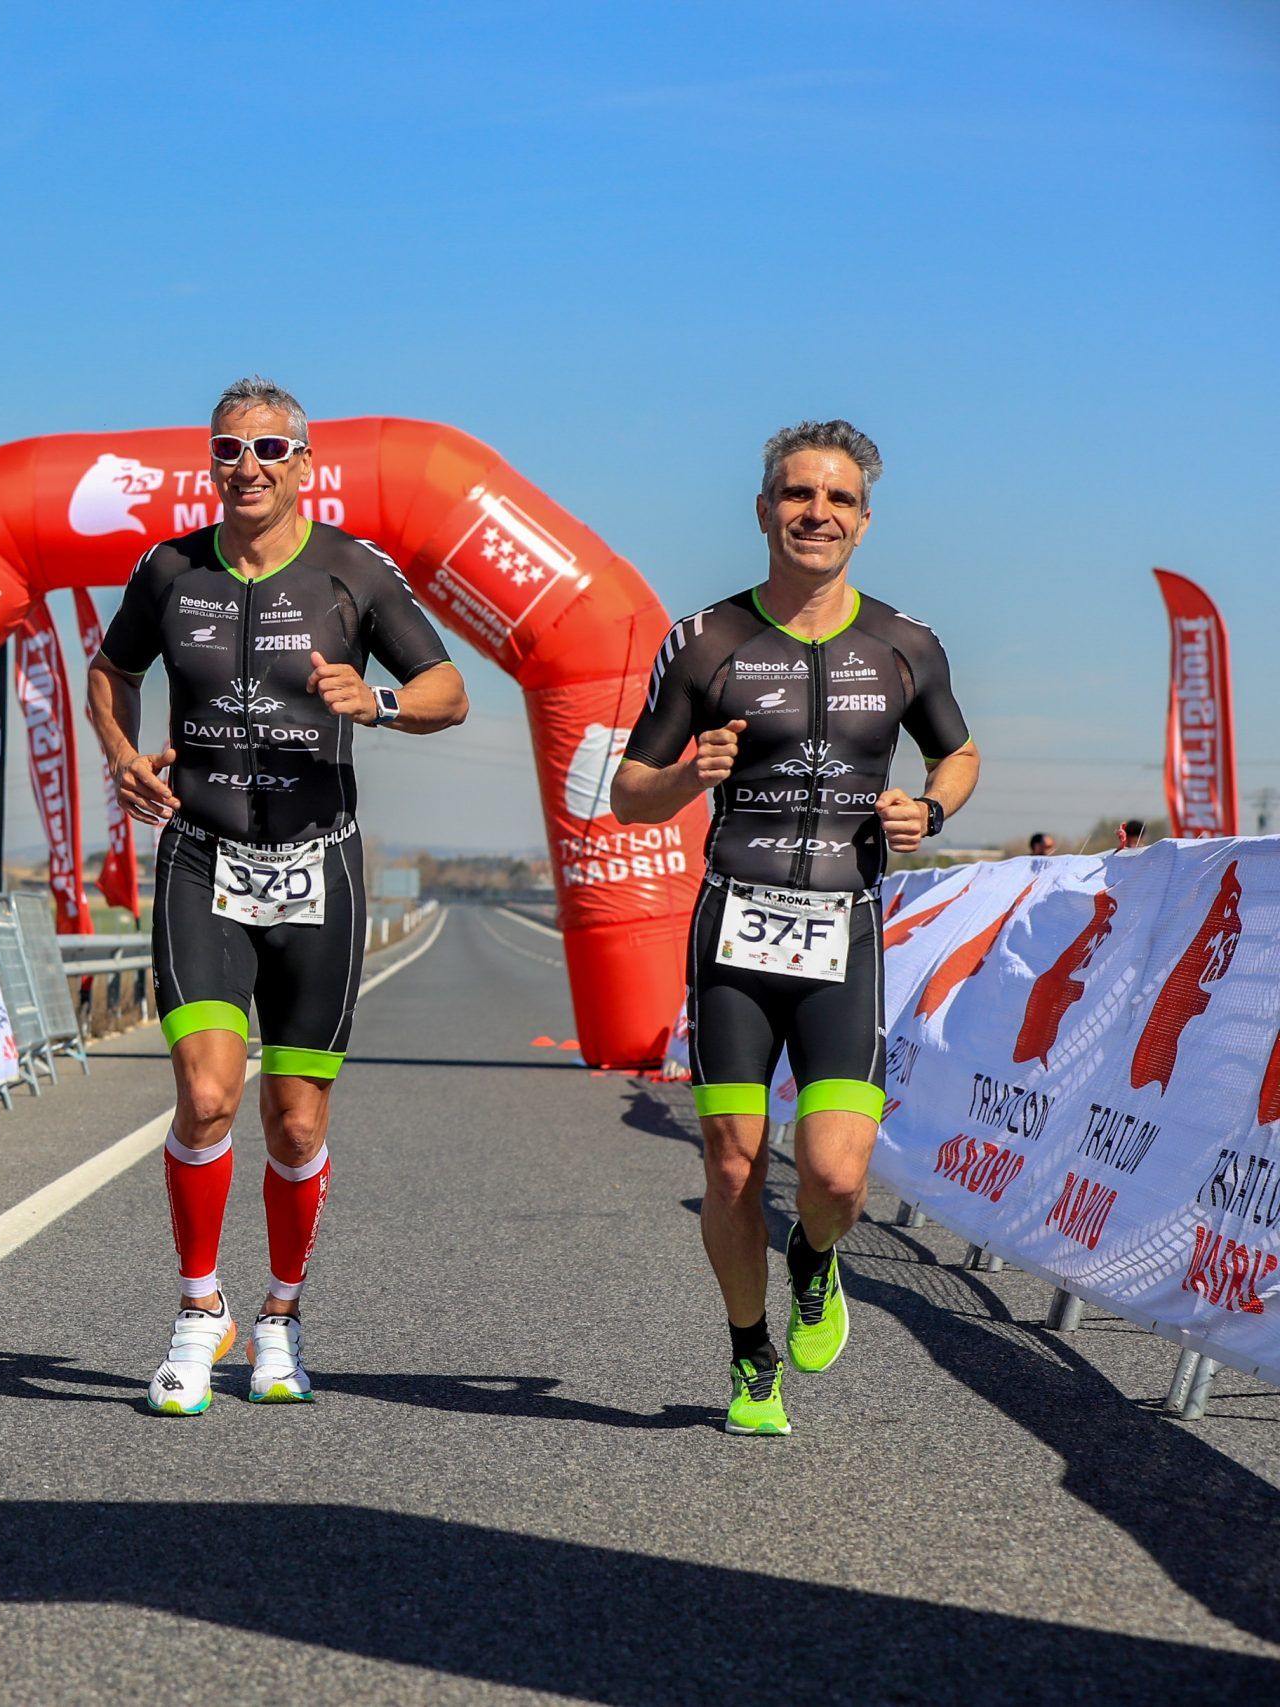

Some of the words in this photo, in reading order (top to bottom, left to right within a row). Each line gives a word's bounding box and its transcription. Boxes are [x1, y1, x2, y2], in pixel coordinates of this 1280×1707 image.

[180, 596, 224, 611] Reebok
[260, 610, 302, 620] FitStudio
[254, 634, 312, 651] 226ERS
[735, 661, 789, 672] Reebok
[831, 668, 877, 679] FitStudio
[827, 694, 887, 712] 226ERS
[184, 721, 246, 738] DAVID
[252, 723, 319, 741] TORO
[207, 772, 300, 788] RUDY
[736, 788, 809, 803] DAVID
[170, 815, 206, 841] HUUB
[325, 820, 356, 847] HUUB
[560, 825, 682, 859] TRIATLON
[748, 837, 852, 853] RUDY
[562, 851, 686, 886] MADRID
[736, 909, 835, 951] 37-F
